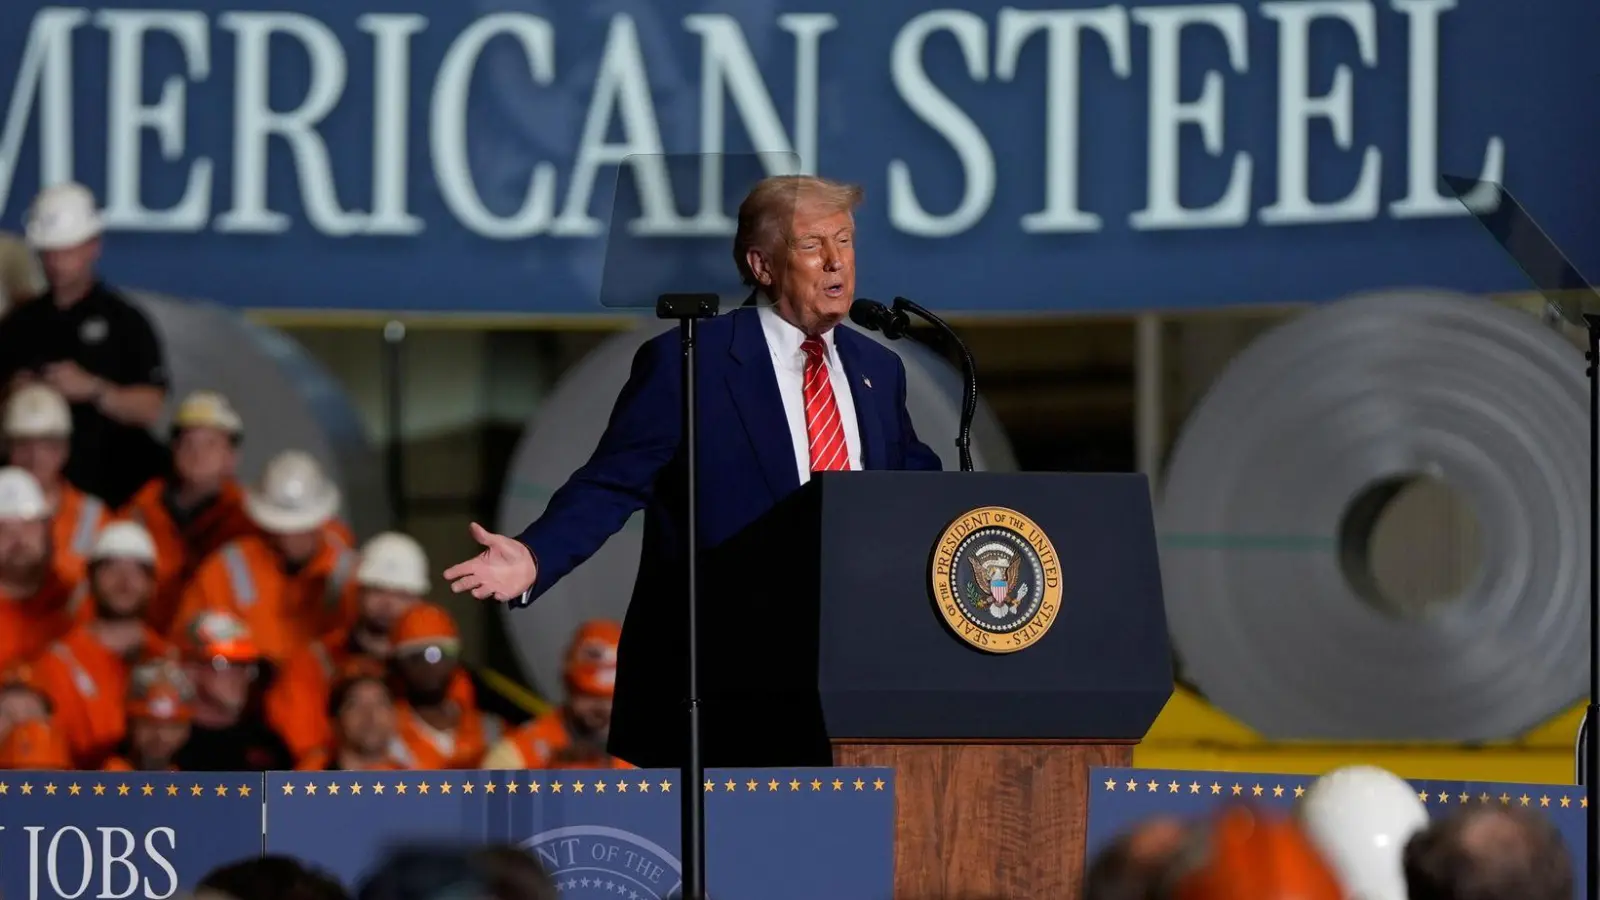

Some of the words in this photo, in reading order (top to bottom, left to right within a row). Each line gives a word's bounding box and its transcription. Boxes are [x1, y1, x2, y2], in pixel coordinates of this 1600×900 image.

[887, 0, 1504, 238] STEEL
[994, 513, 1007, 523] OF
[1009, 516, 1025, 531] THE
[937, 512, 991, 576] PRESIDENT
[1028, 529, 1058, 588] UNITED
[938, 581, 950, 601] THE
[945, 604, 956, 617] OF
[956, 615, 990, 645] SEAL
[1012, 601, 1054, 645] STATES
[23, 825, 178, 900] JOBS
[591, 842, 619, 862] OF
[624, 850, 665, 884] THE
